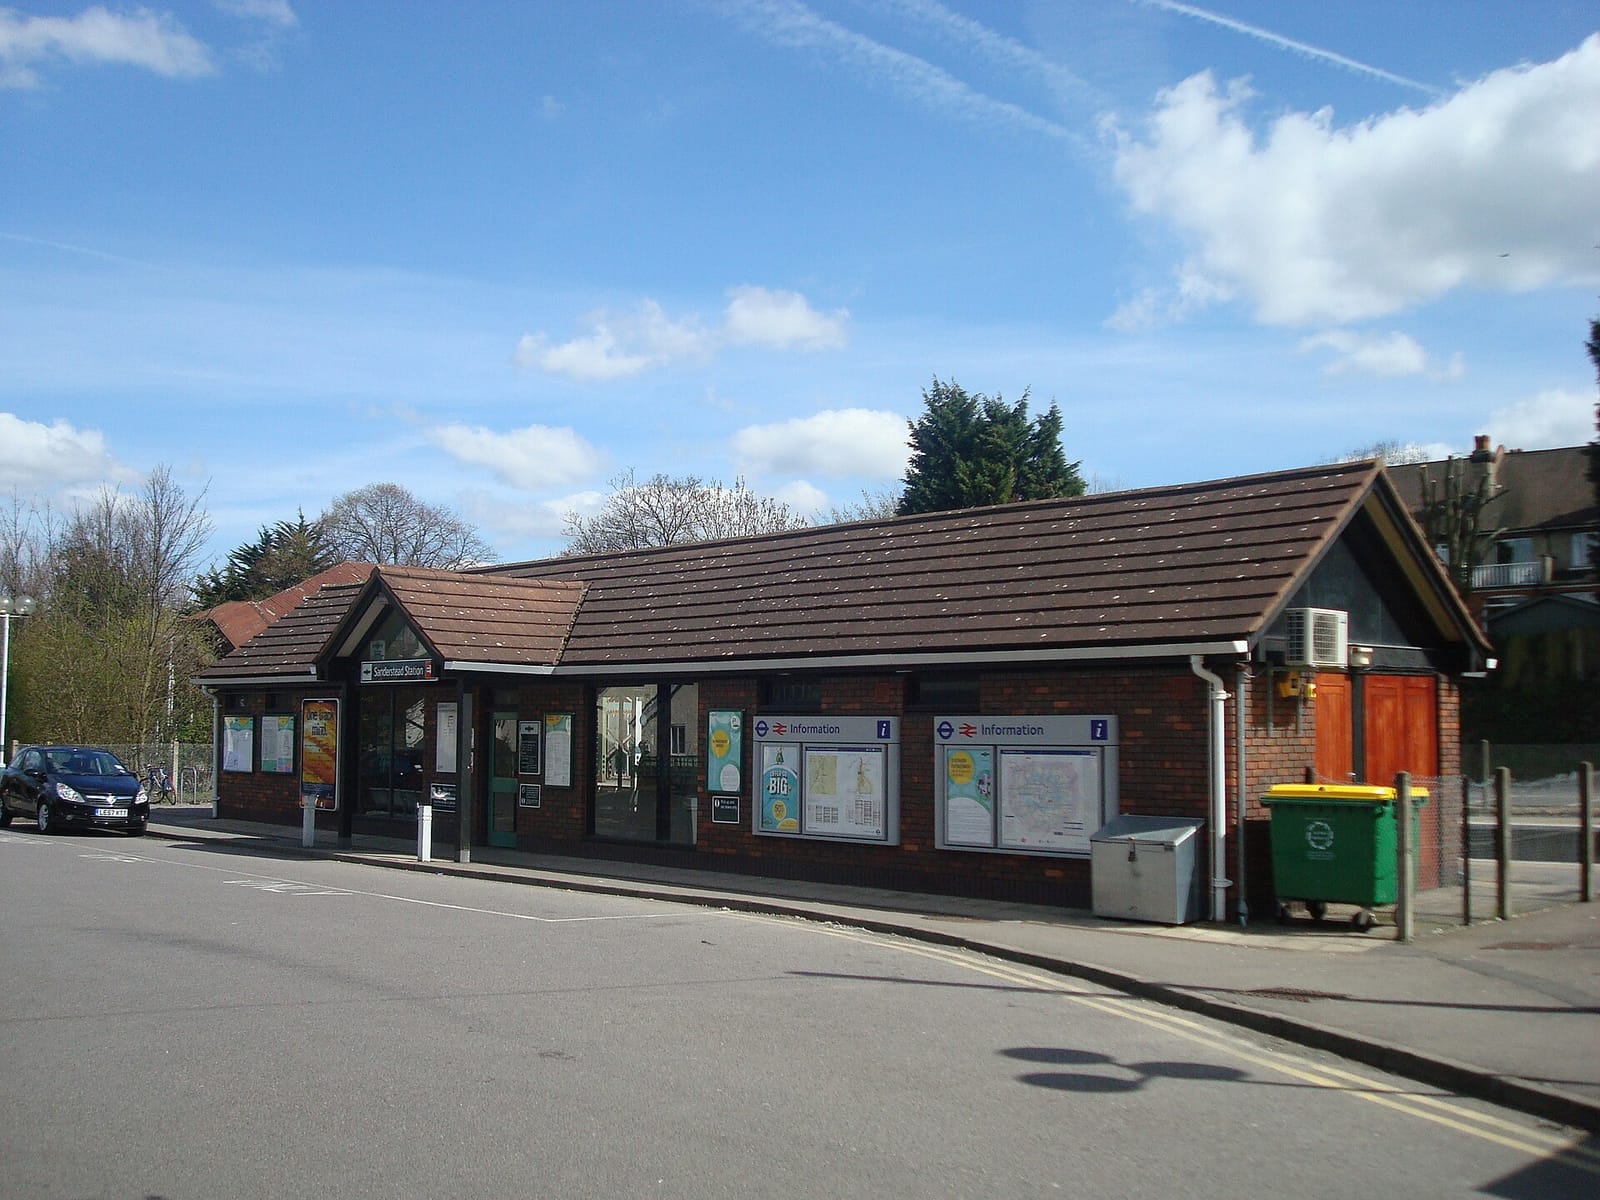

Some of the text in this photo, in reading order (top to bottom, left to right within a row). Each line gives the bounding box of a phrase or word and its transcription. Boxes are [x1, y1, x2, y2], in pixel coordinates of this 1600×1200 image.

[373, 664, 424, 677] Sanderstead Station
[790, 723, 840, 734] Information
[981, 724, 1044, 736] Information
[769, 777, 788, 795] BIG
